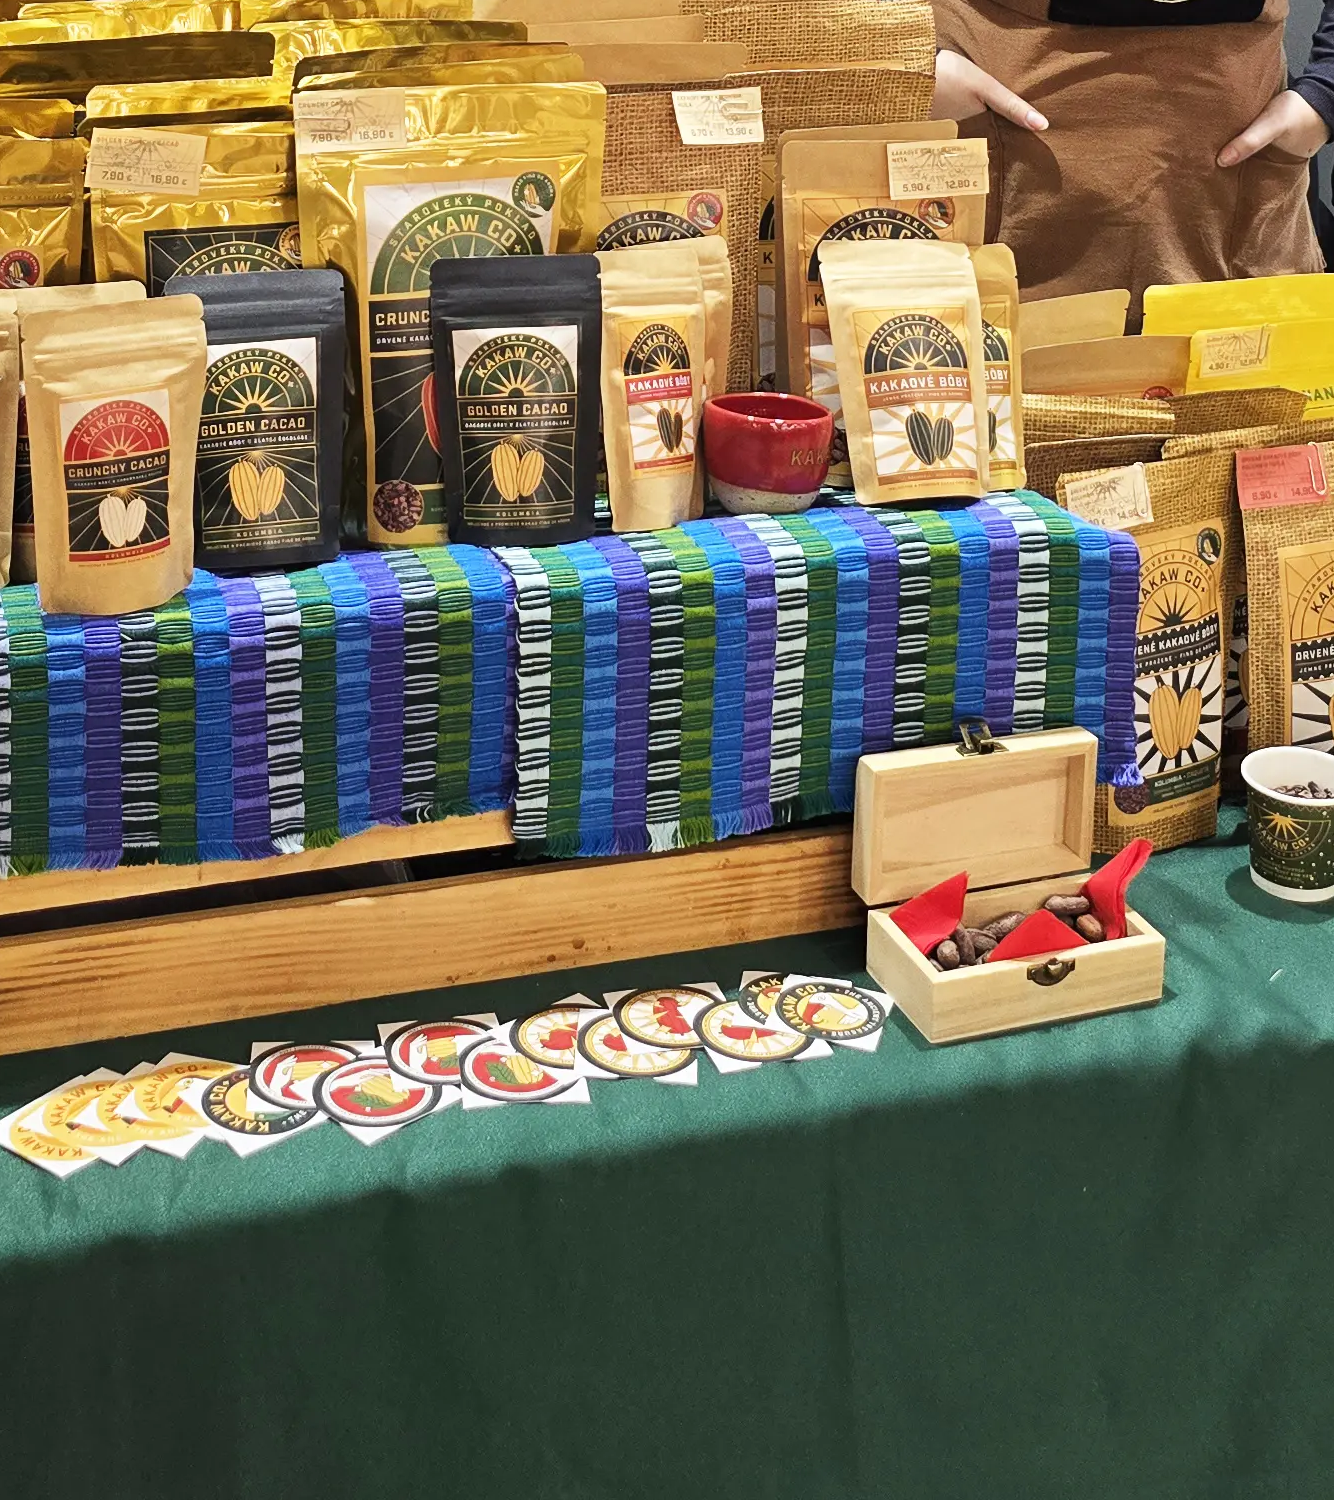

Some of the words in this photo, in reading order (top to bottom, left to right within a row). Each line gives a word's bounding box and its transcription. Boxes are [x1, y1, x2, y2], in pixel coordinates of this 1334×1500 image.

[389, 194, 474, 247] STAROVEKÝ
[484, 198, 536, 240] POKLAD
[400, 214, 480, 265] KAKAW
[468, 333, 525, 367] STAROVEKÝ
[636, 333, 666, 361] KAKAW
[878, 325, 925, 356] KAKAW
[267, 351, 306, 380] POKLAD
[475, 346, 528, 378] KAKAW
[208, 361, 264, 396] KAKAW
[628, 376, 675, 393] KAKAOVÉ
[869, 375, 935, 395] KAKAOVÉ
[939, 373, 968, 388] BÔBY
[467, 404, 518, 417] GOLDEN
[523, 402, 568, 416] CACAO
[81, 412, 127, 445] KAKAW
[201, 419, 256, 437] GOLDEN
[260, 416, 306, 432] CACAO
[68, 462, 126, 480] CRUNCHY
[129, 454, 168, 474] CACAO
[1158, 630, 1201, 650] KAKAOVÉ
[782, 994, 812, 1032] KAKAW
[209, 1105, 271, 1134] KAKAW
